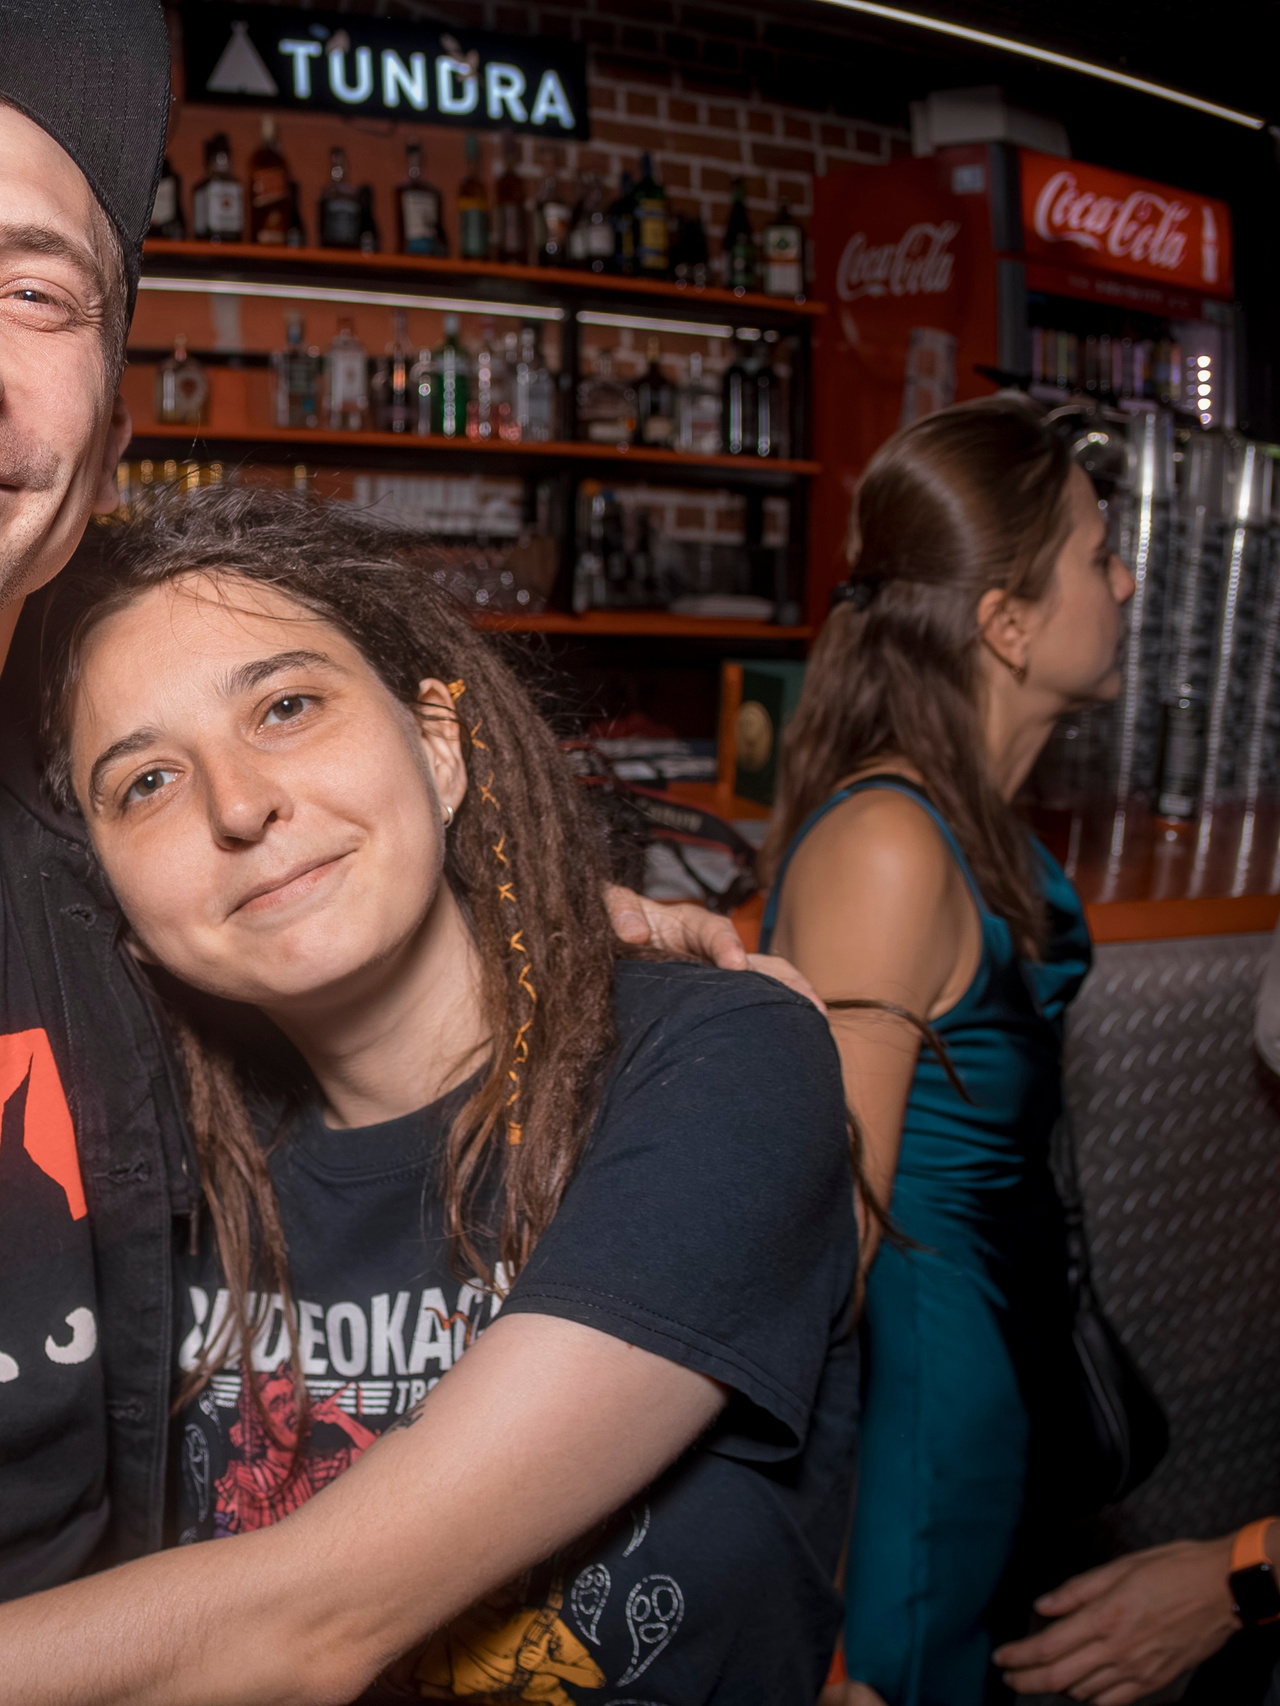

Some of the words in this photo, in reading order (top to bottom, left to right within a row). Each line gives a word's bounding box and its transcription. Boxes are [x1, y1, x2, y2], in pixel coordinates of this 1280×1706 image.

[278, 38, 576, 129] TUNDRA
[836, 220, 961, 302] Coca-Cola
[1034, 171, 1191, 269] Coca-Cola
